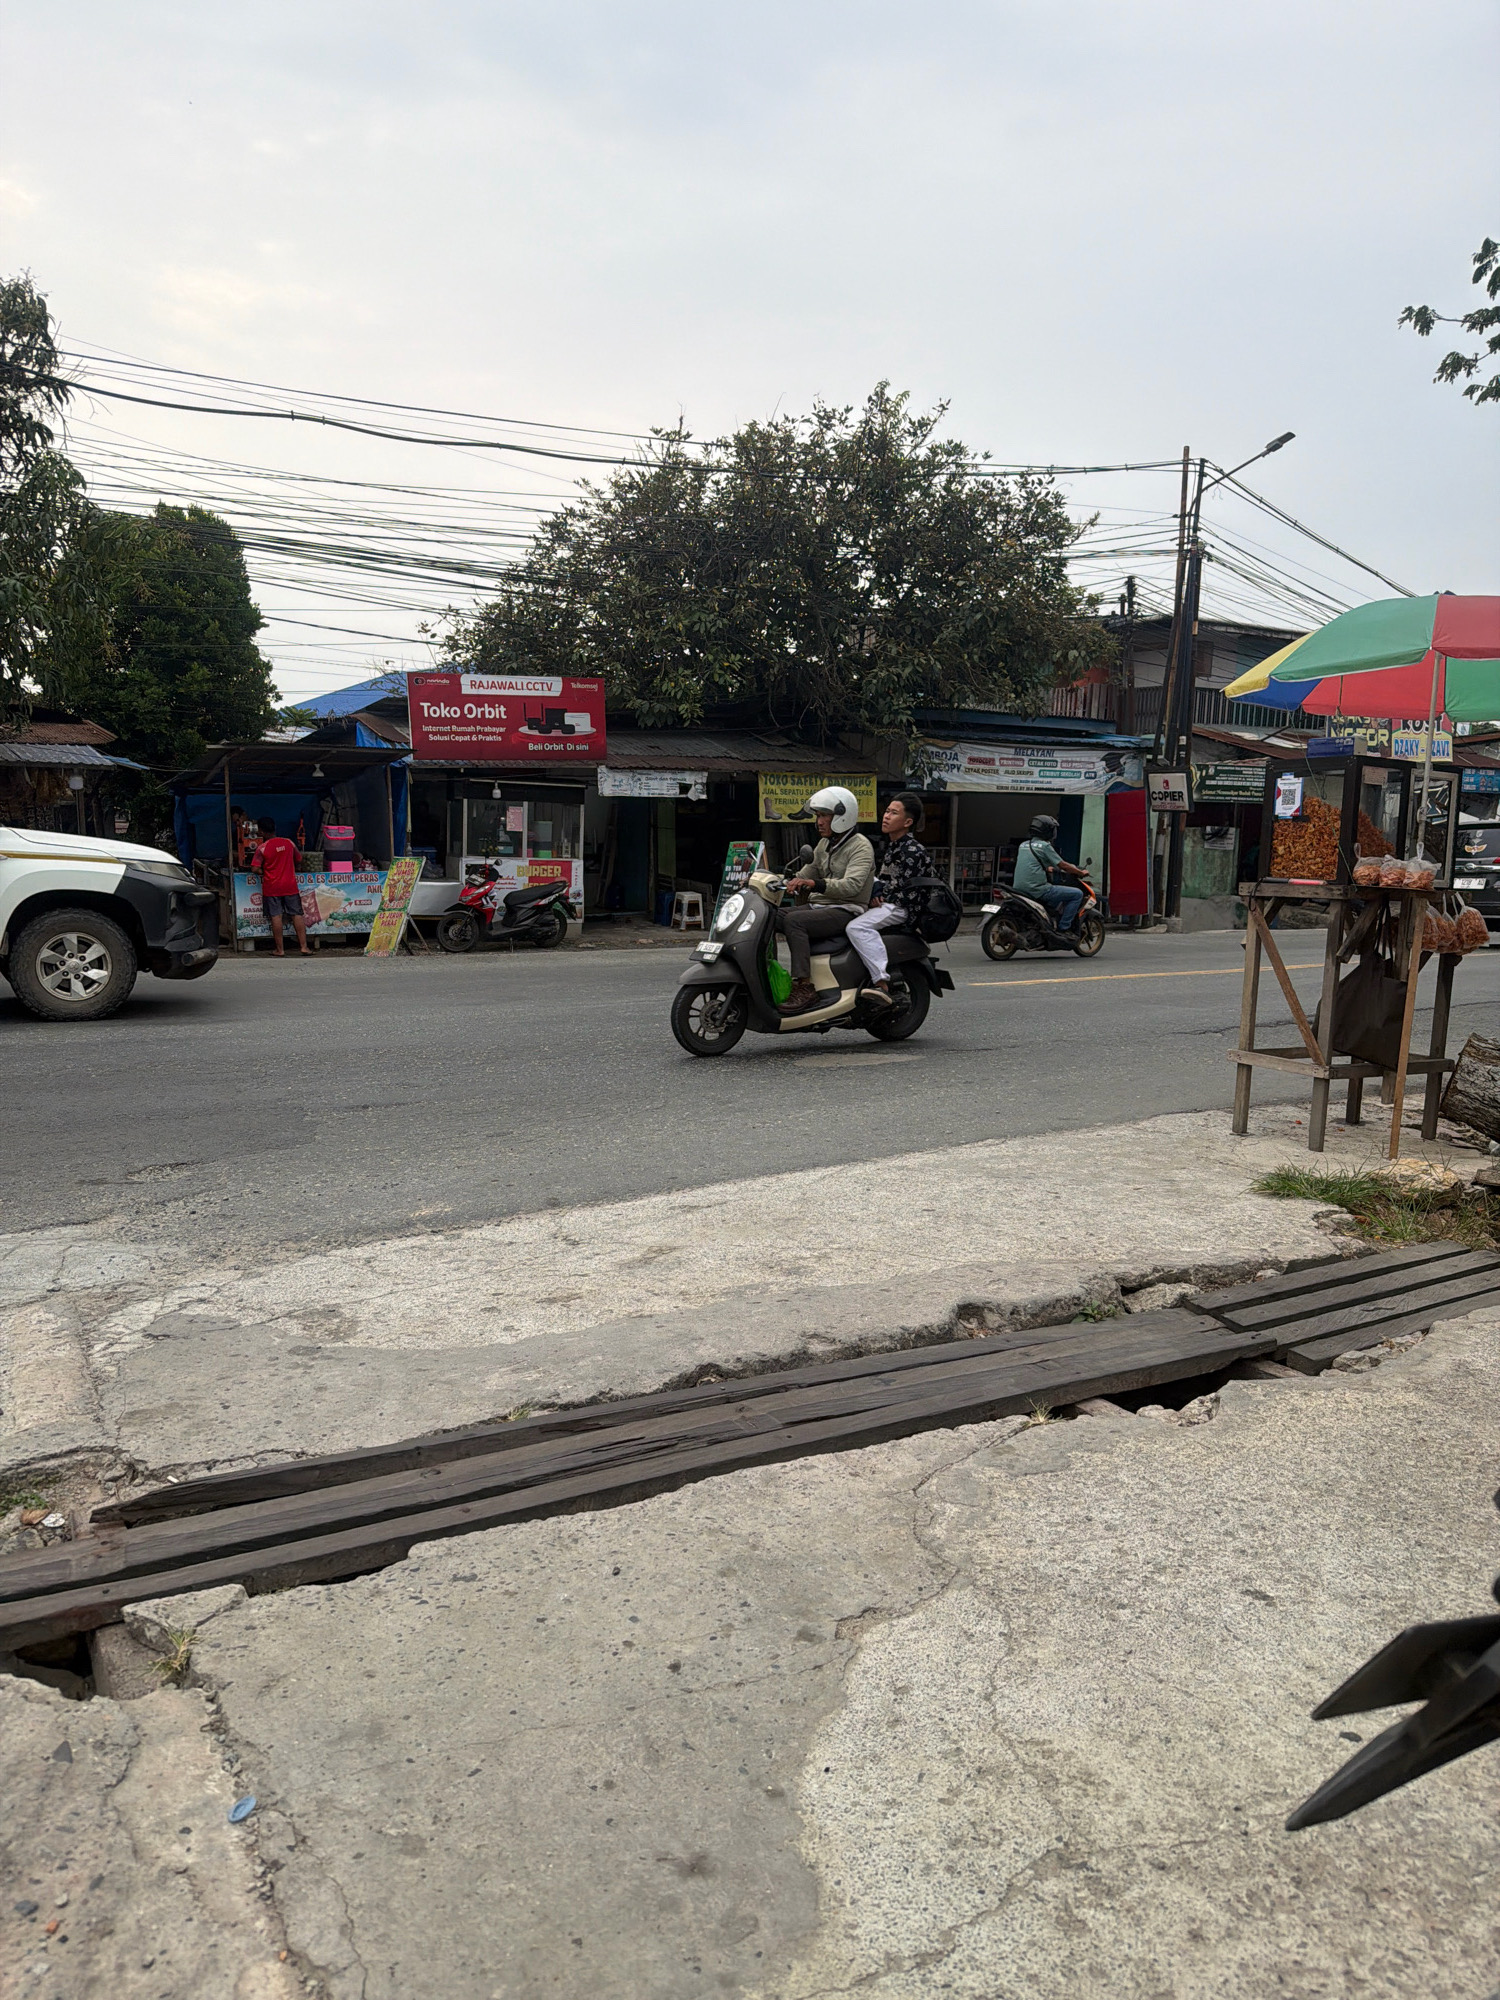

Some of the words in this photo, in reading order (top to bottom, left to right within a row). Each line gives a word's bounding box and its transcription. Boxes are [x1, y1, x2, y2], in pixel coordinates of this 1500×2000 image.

[470, 680, 523, 691] RAJAWALI
[526, 681, 553, 691] CCTV
[420, 702, 461, 718] Toko
[463, 703, 507, 719] Orbit
[422, 724, 451, 732] Internet
[476, 725, 507, 734] Prabayar
[450, 734, 471, 742] Cepat
[471, 734, 478, 742] &
[478, 734, 502, 742] Praktis
[528, 742, 543, 751] Beli
[543, 743, 565, 751] Orbit
[1395, 738, 1420, 756] DZAKY
[1013, 748, 1056, 758] MELAYANI
[763, 774, 788, 786] TOKO
[790, 774, 825, 788] SAFETY
[780, 789, 804, 797] SEPATU
[1151, 791, 1184, 801] COPIER
[517, 865, 562, 878] BURGER
[247, 876, 257, 885] ES
[316, 875, 326, 884] ES
[328, 874, 353, 883] JERUK
[355, 874, 379, 883] PERAS
